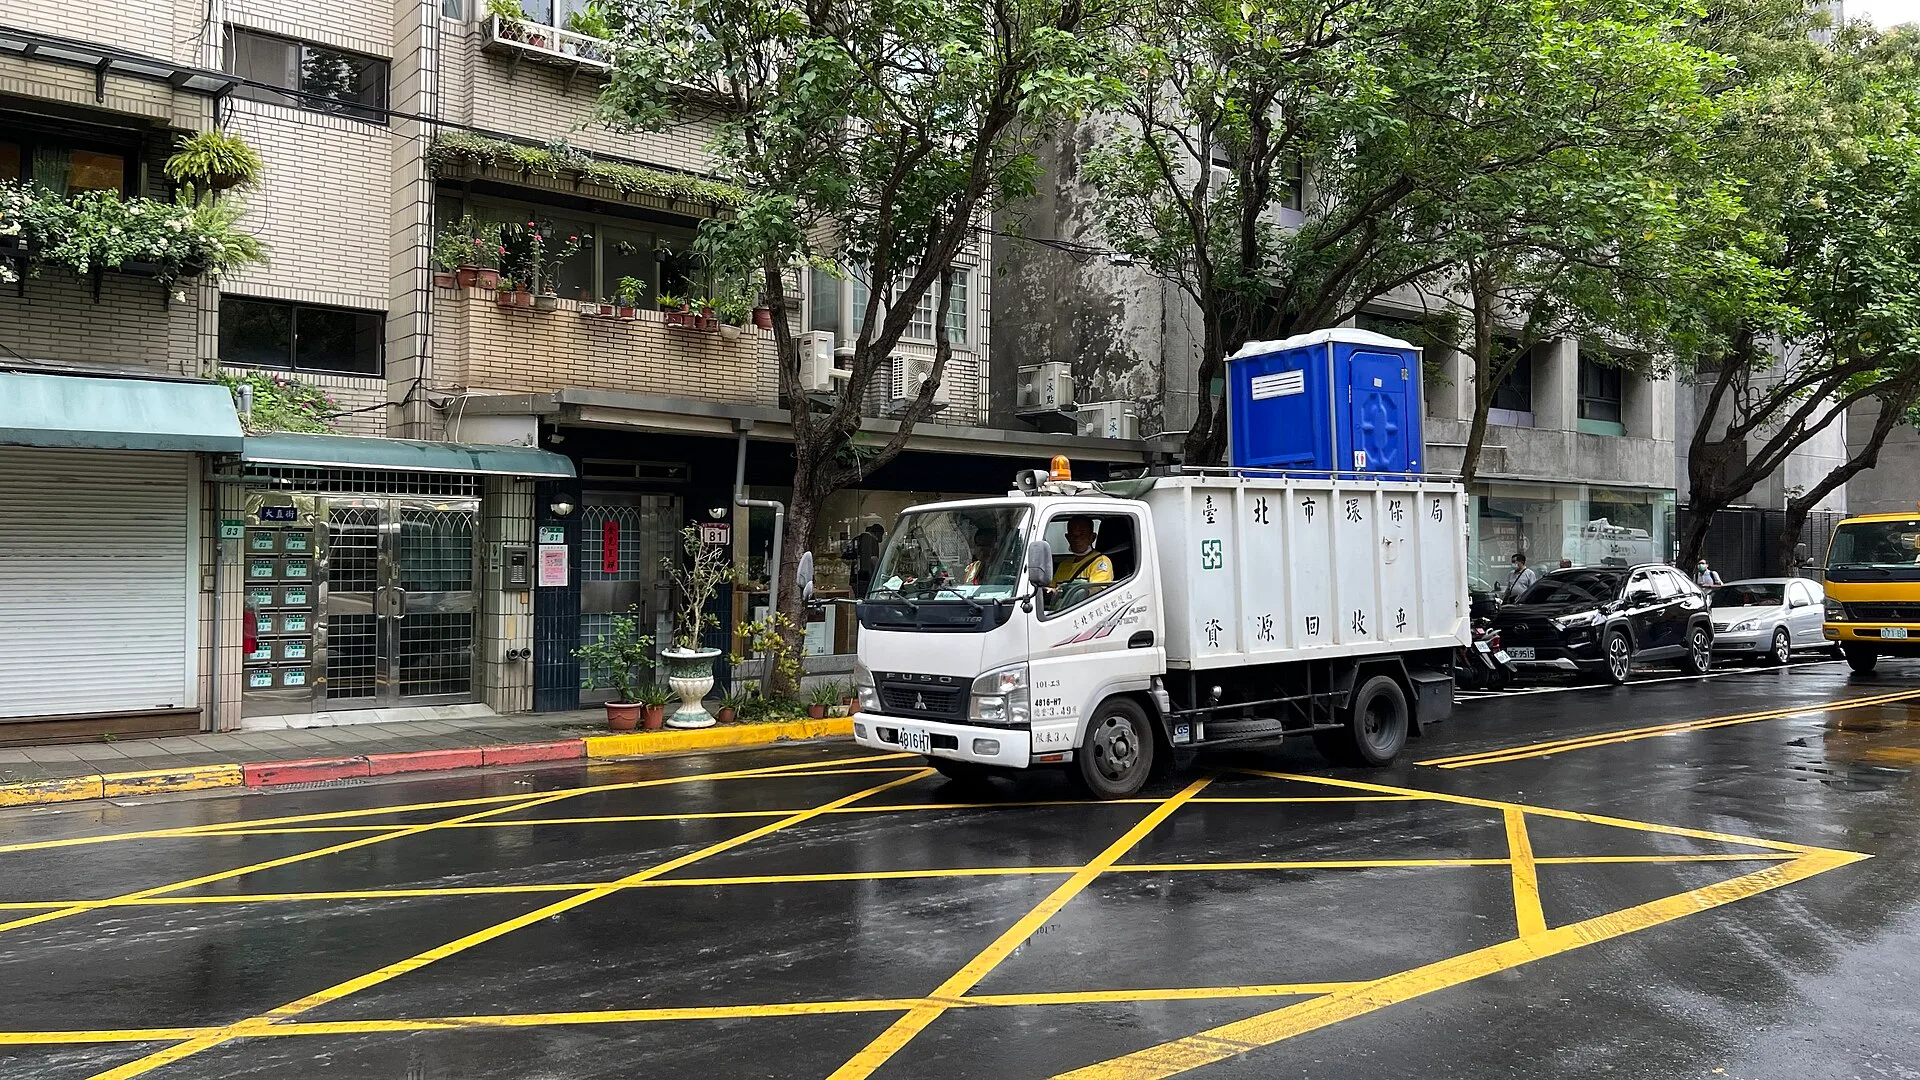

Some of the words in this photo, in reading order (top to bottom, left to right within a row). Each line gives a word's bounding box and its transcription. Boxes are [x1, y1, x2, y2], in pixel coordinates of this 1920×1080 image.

[1046, 382, 1054, 405] 冰點
[265, 508, 295, 519] 大直街
[1203, 495, 1443, 525] 臺北市環保局
[226, 527, 239, 536] 83
[549, 533, 559, 541] 81
[709, 531, 722, 542] 81
[1204, 606, 1407, 648] 資源回收車
[886, 672, 952, 683] FUSO
[1034, 697, 1062, 707] 4816-H7
